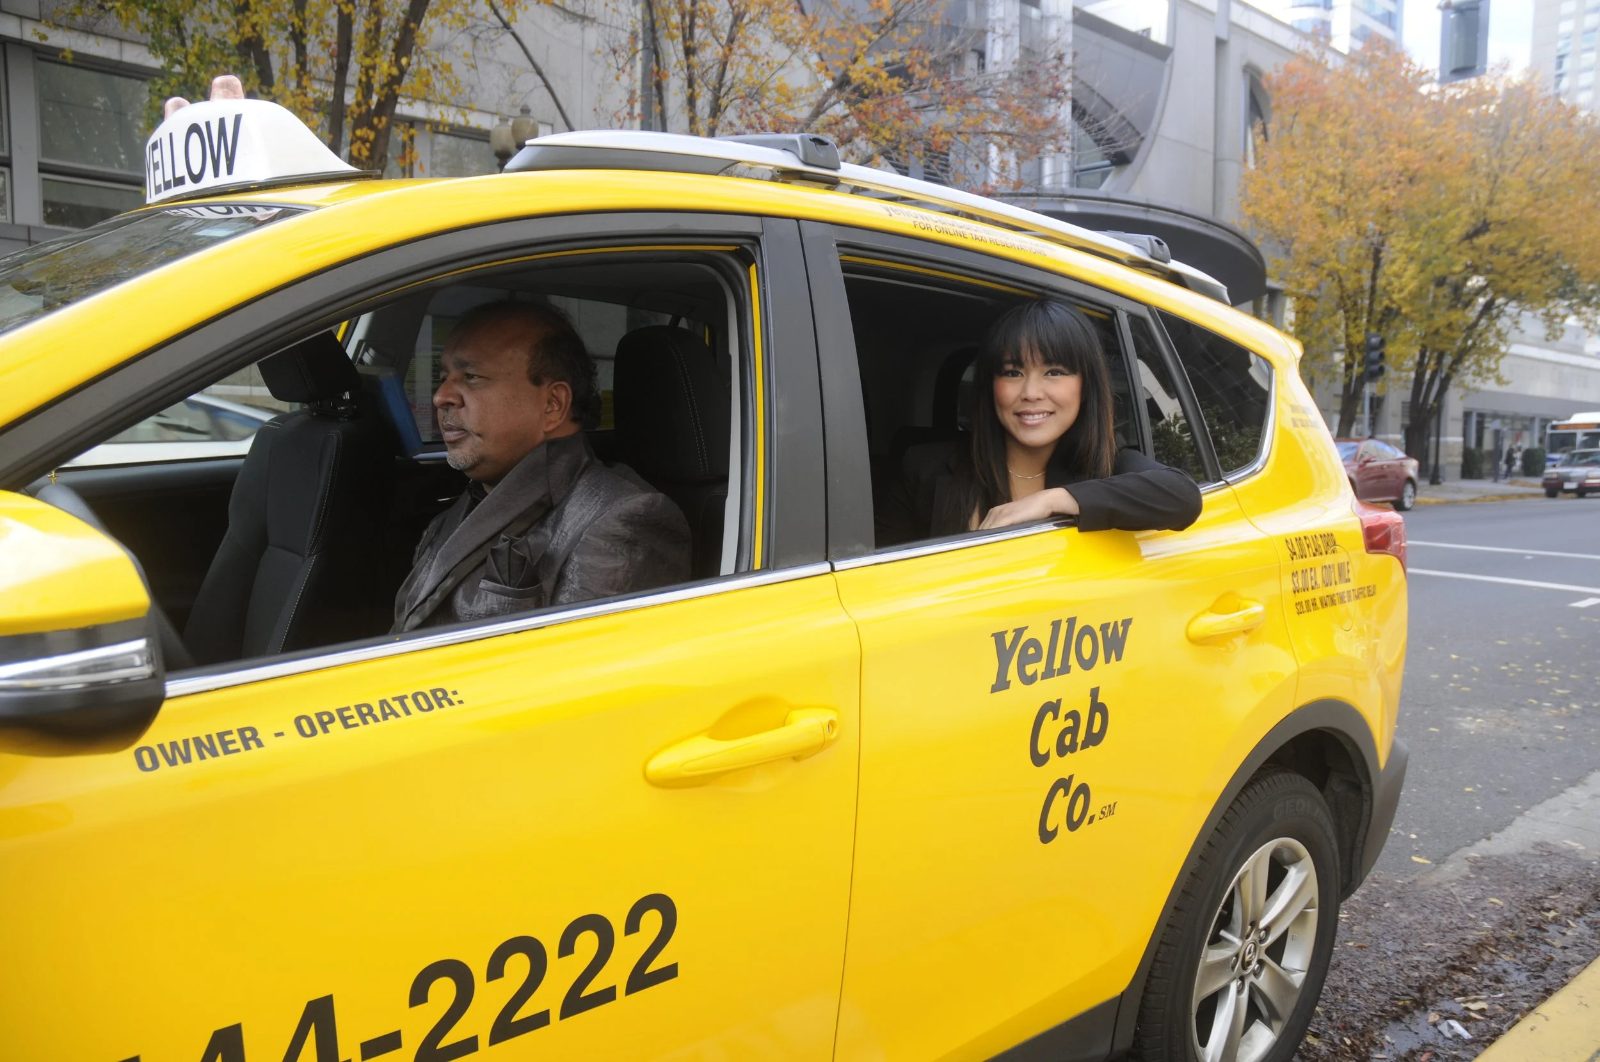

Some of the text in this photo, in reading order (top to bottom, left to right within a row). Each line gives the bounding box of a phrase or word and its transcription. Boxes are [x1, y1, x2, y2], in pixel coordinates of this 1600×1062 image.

[145, 113, 243, 199] YELLOW
[912, 220, 933, 232] FOR
[934, 223, 969, 239] ONLINE
[990, 615, 1133, 694] Yellow
[133, 725, 264, 773] OWNER
[292, 686, 465, 739] OPERATOR:
[1029, 686, 1110, 768] Cab
[1038, 773, 1118, 845] Co. SM
